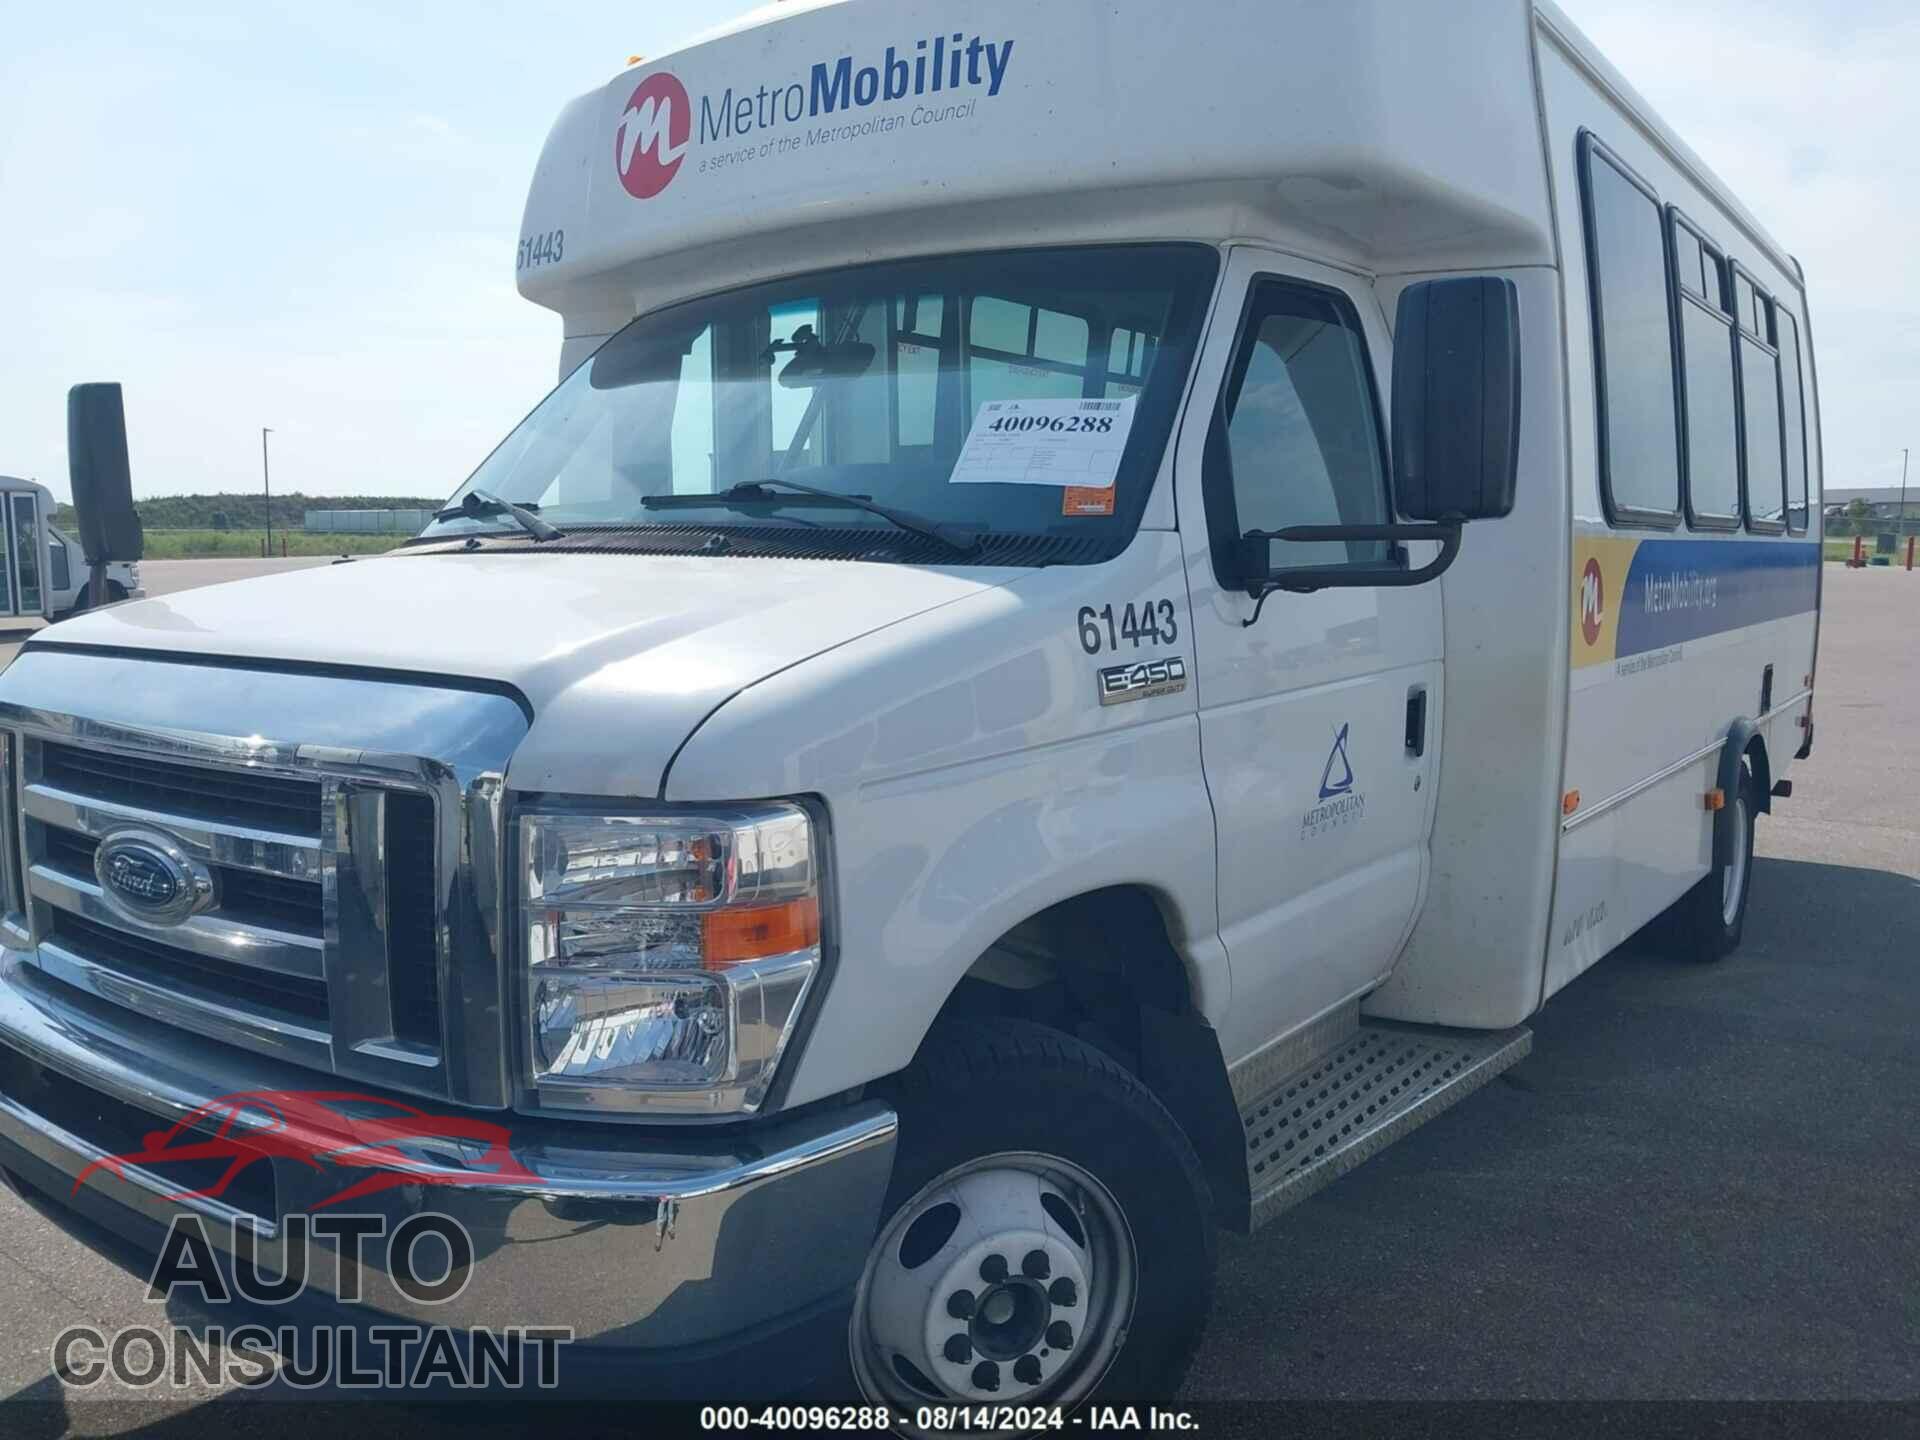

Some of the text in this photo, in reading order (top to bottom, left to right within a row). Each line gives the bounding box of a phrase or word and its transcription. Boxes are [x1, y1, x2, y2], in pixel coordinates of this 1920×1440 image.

[700, 33, 1014, 144] MetroMobility
[699, 99, 977, 172] a service of the Metropolitan Council
[988, 416, 1113, 433] 40096288
[1078, 599, 1177, 655] 61443
